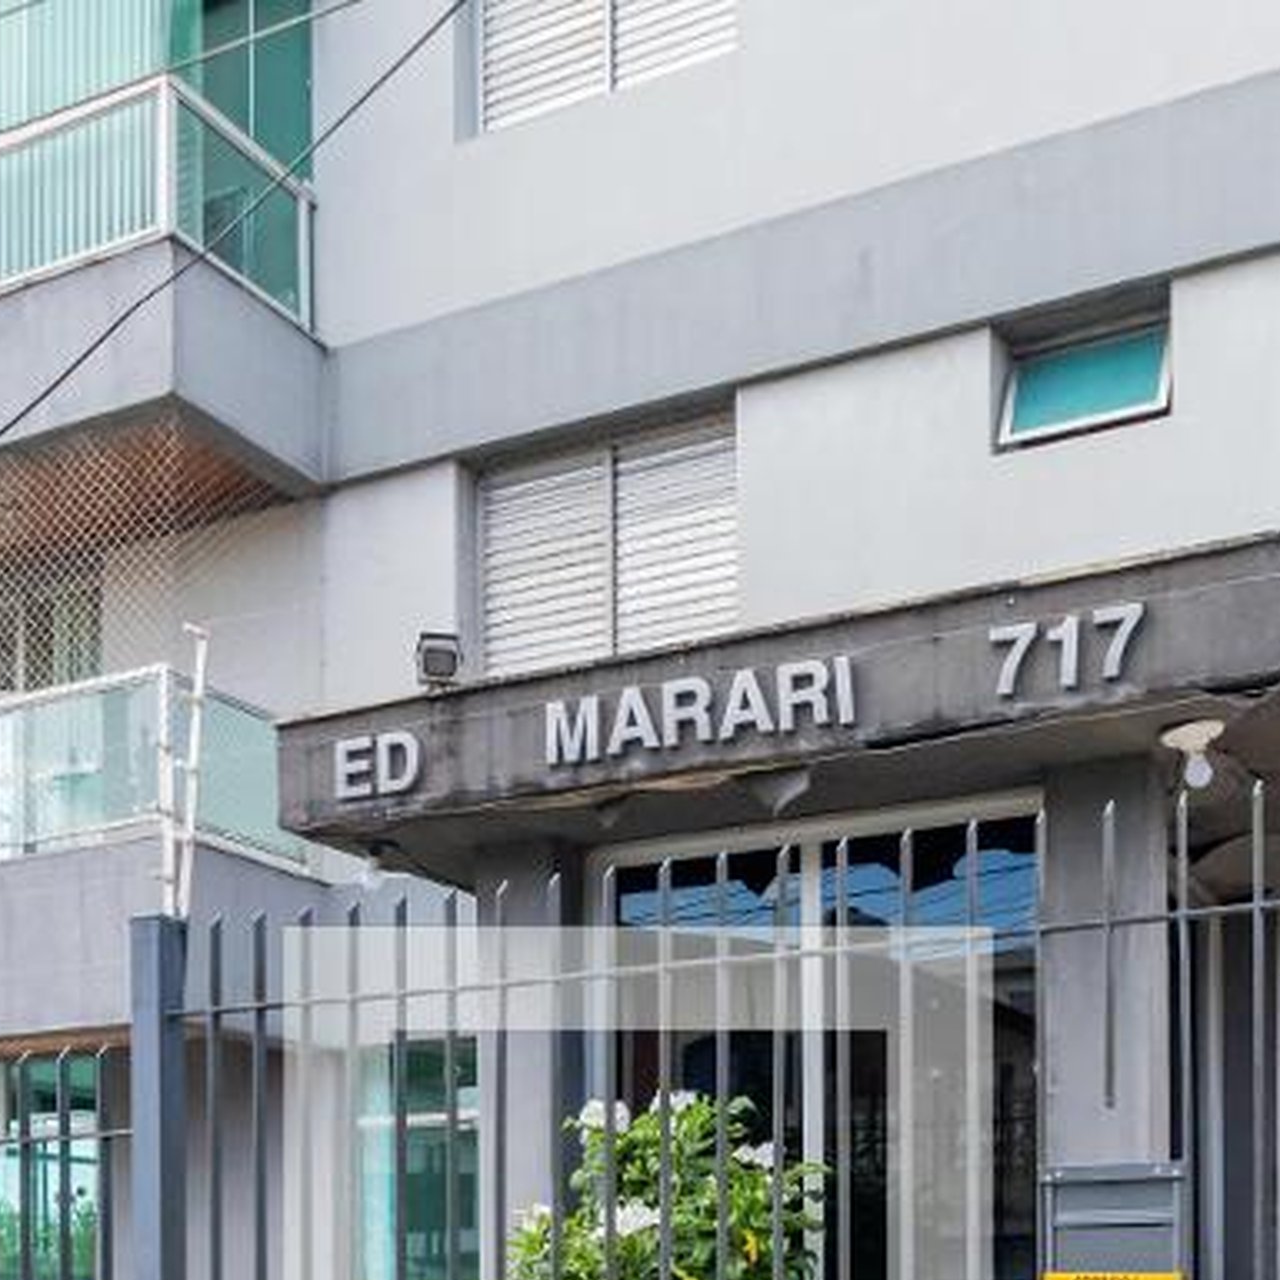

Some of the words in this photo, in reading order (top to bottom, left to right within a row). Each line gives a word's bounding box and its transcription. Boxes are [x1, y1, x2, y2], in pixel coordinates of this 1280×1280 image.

[335, 732, 419, 799] ED
[545, 655, 855, 764] MARARI
[989, 602, 1144, 694] 717
